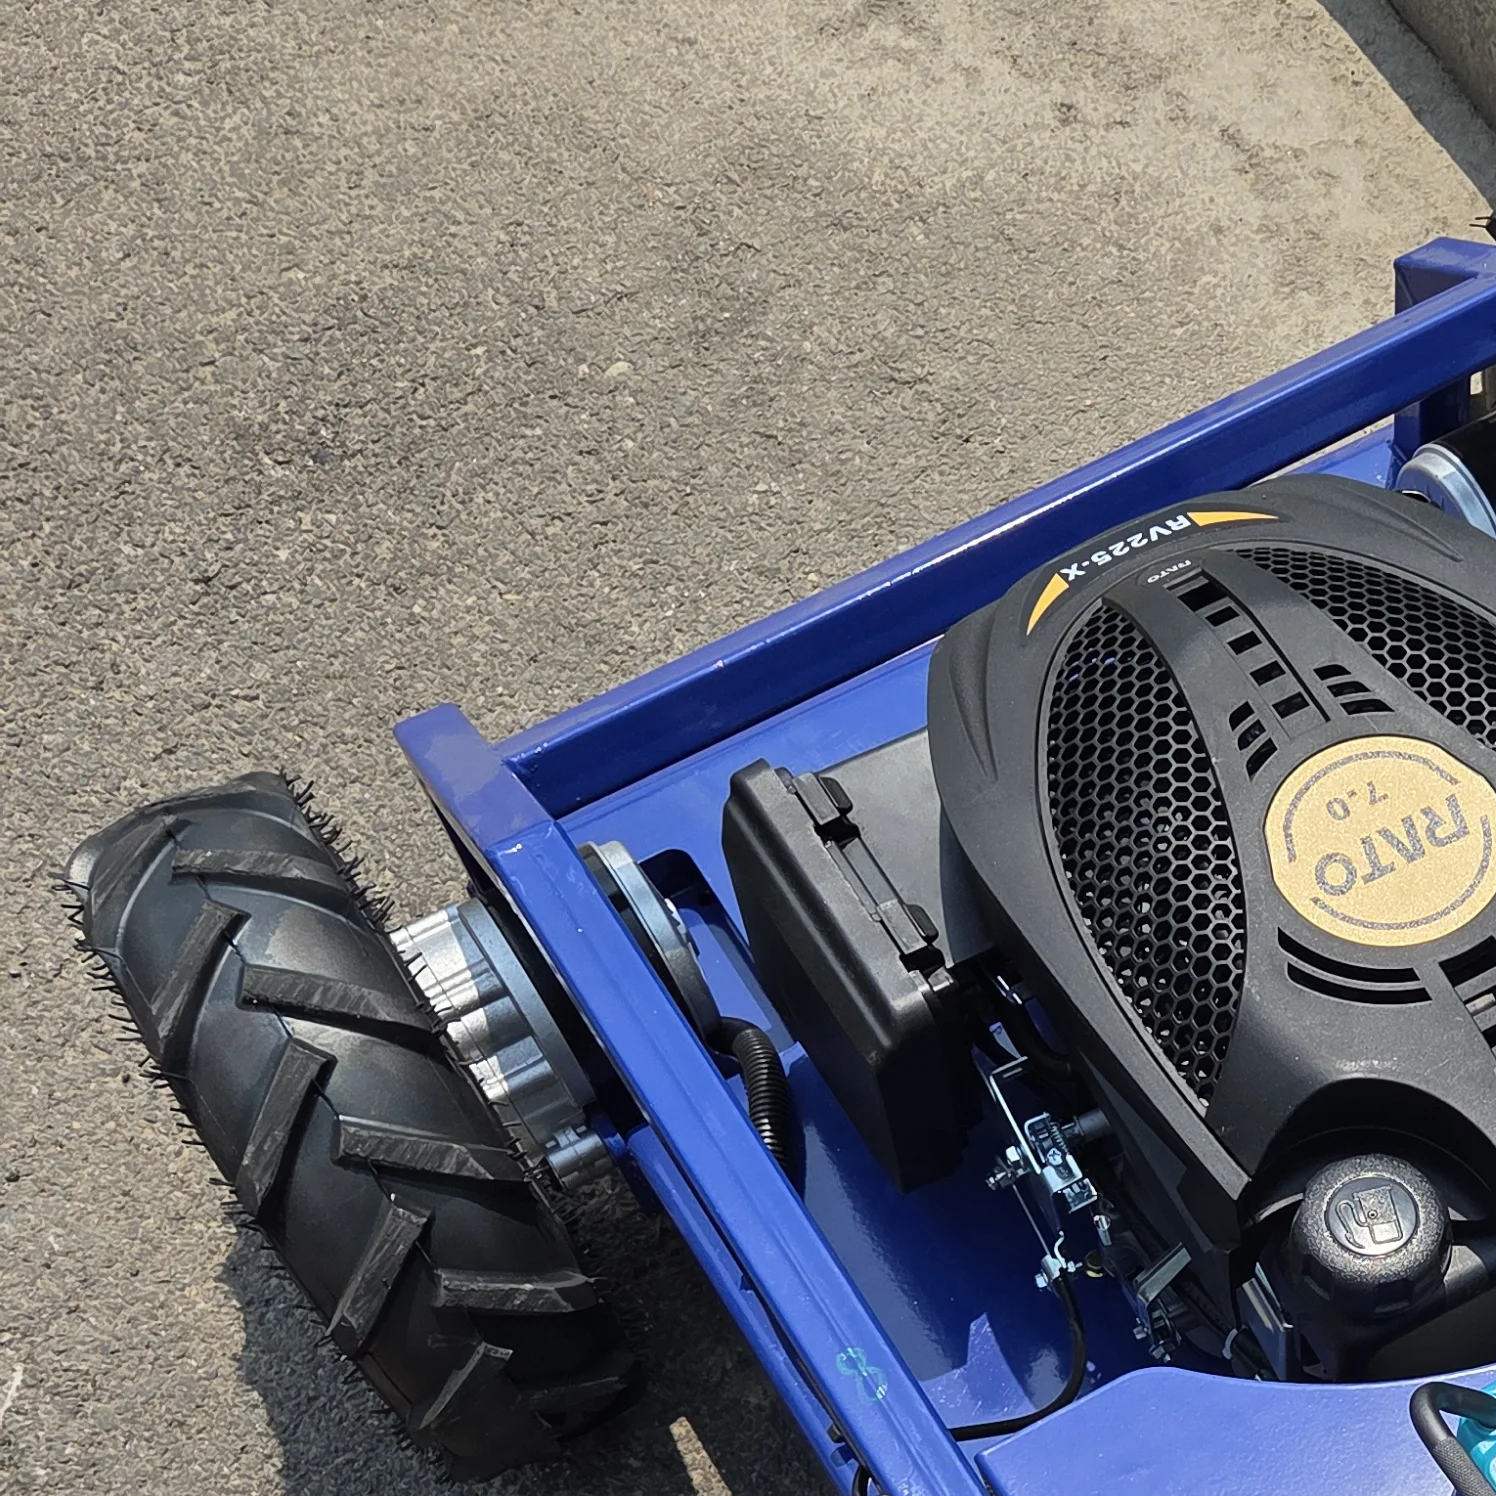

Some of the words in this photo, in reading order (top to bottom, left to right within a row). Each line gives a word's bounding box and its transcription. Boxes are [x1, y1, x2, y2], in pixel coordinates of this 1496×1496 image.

[1060, 514, 1191, 581] RV225-X
[1147, 559, 1192, 583] RATO
[1326, 780, 1389, 820] 7.0
[1314, 794, 1469, 896] RATO
